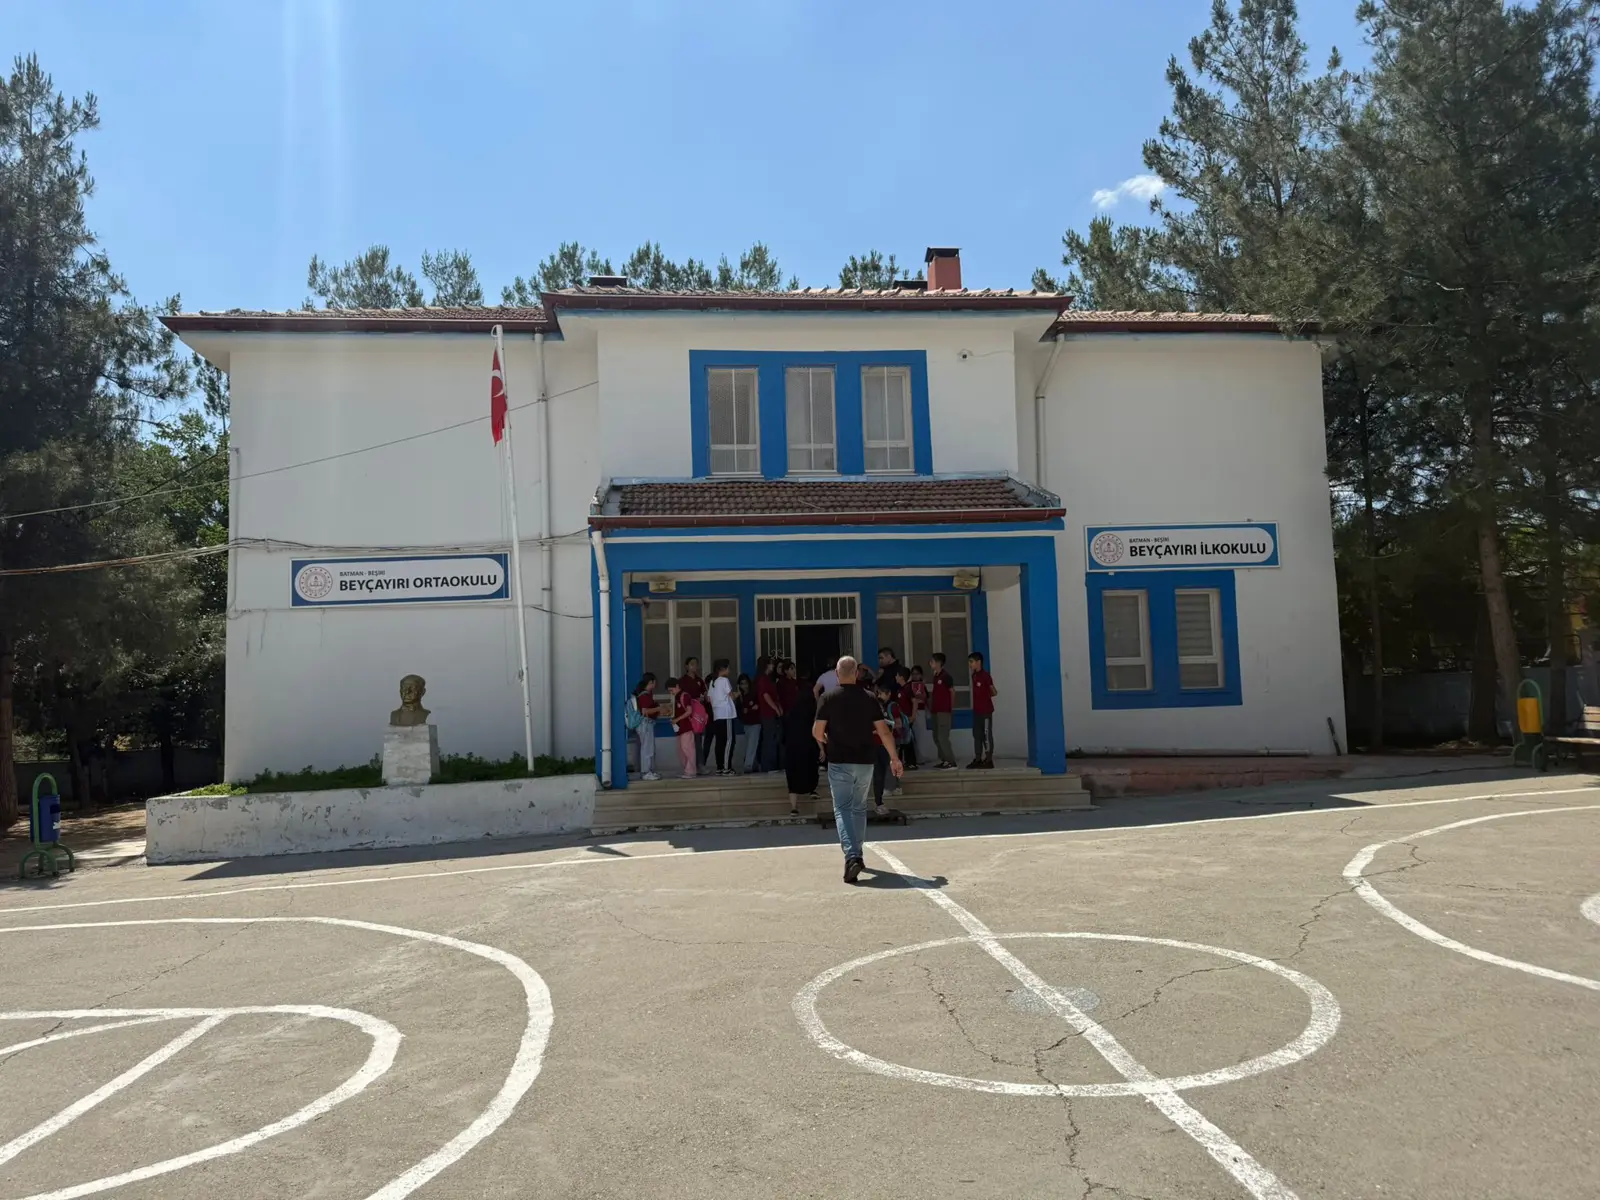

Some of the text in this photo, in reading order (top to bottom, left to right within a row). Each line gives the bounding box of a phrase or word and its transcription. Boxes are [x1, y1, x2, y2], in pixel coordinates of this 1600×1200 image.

[1129, 544, 1197, 559] BEYÇAYIRI
[1200, 541, 1266, 556] İLKOKULU
[339, 578, 410, 593] BEYÇAYIRI
[413, 574, 498, 589] ORTAOKULU
